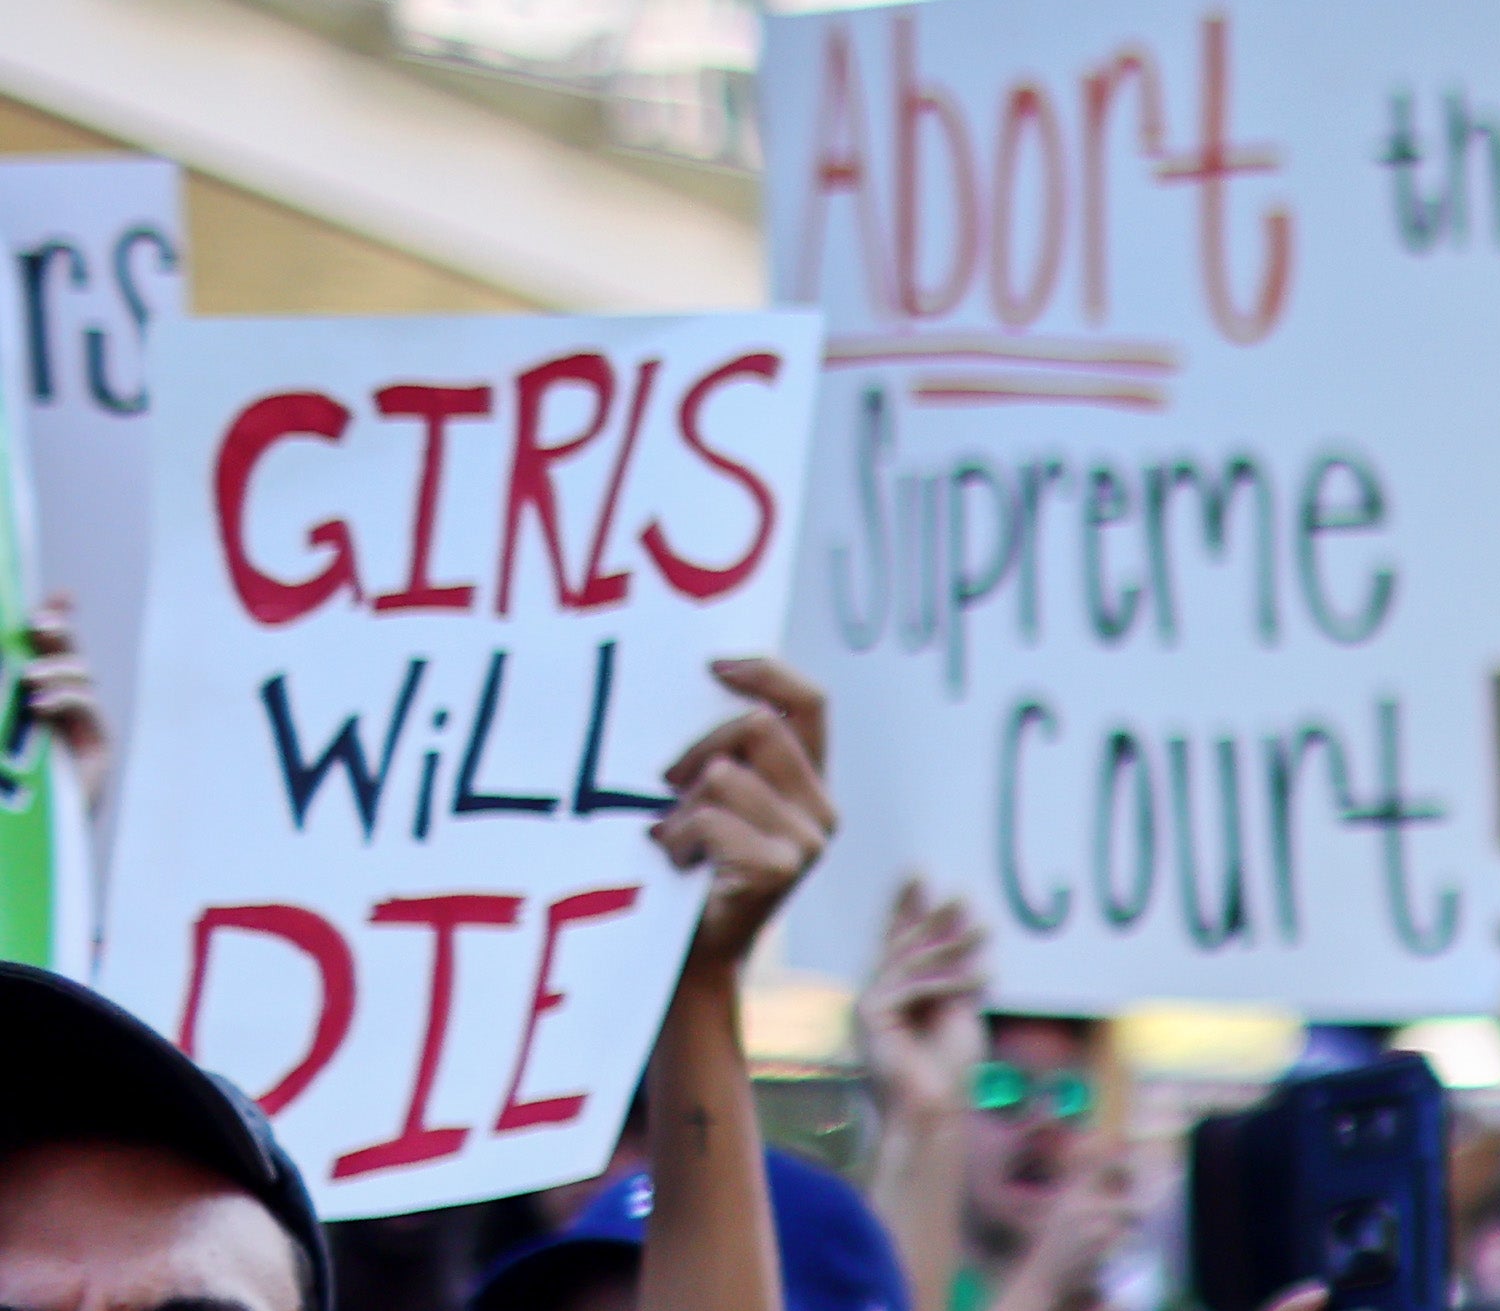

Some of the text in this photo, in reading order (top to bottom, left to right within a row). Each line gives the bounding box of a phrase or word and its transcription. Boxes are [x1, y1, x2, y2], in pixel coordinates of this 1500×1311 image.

[806, 7, 1293, 348] Abort
[213, 352, 782, 630] GIRLS
[824, 385, 1396, 698] Supreme
[176, 887, 643, 1182] DIE
